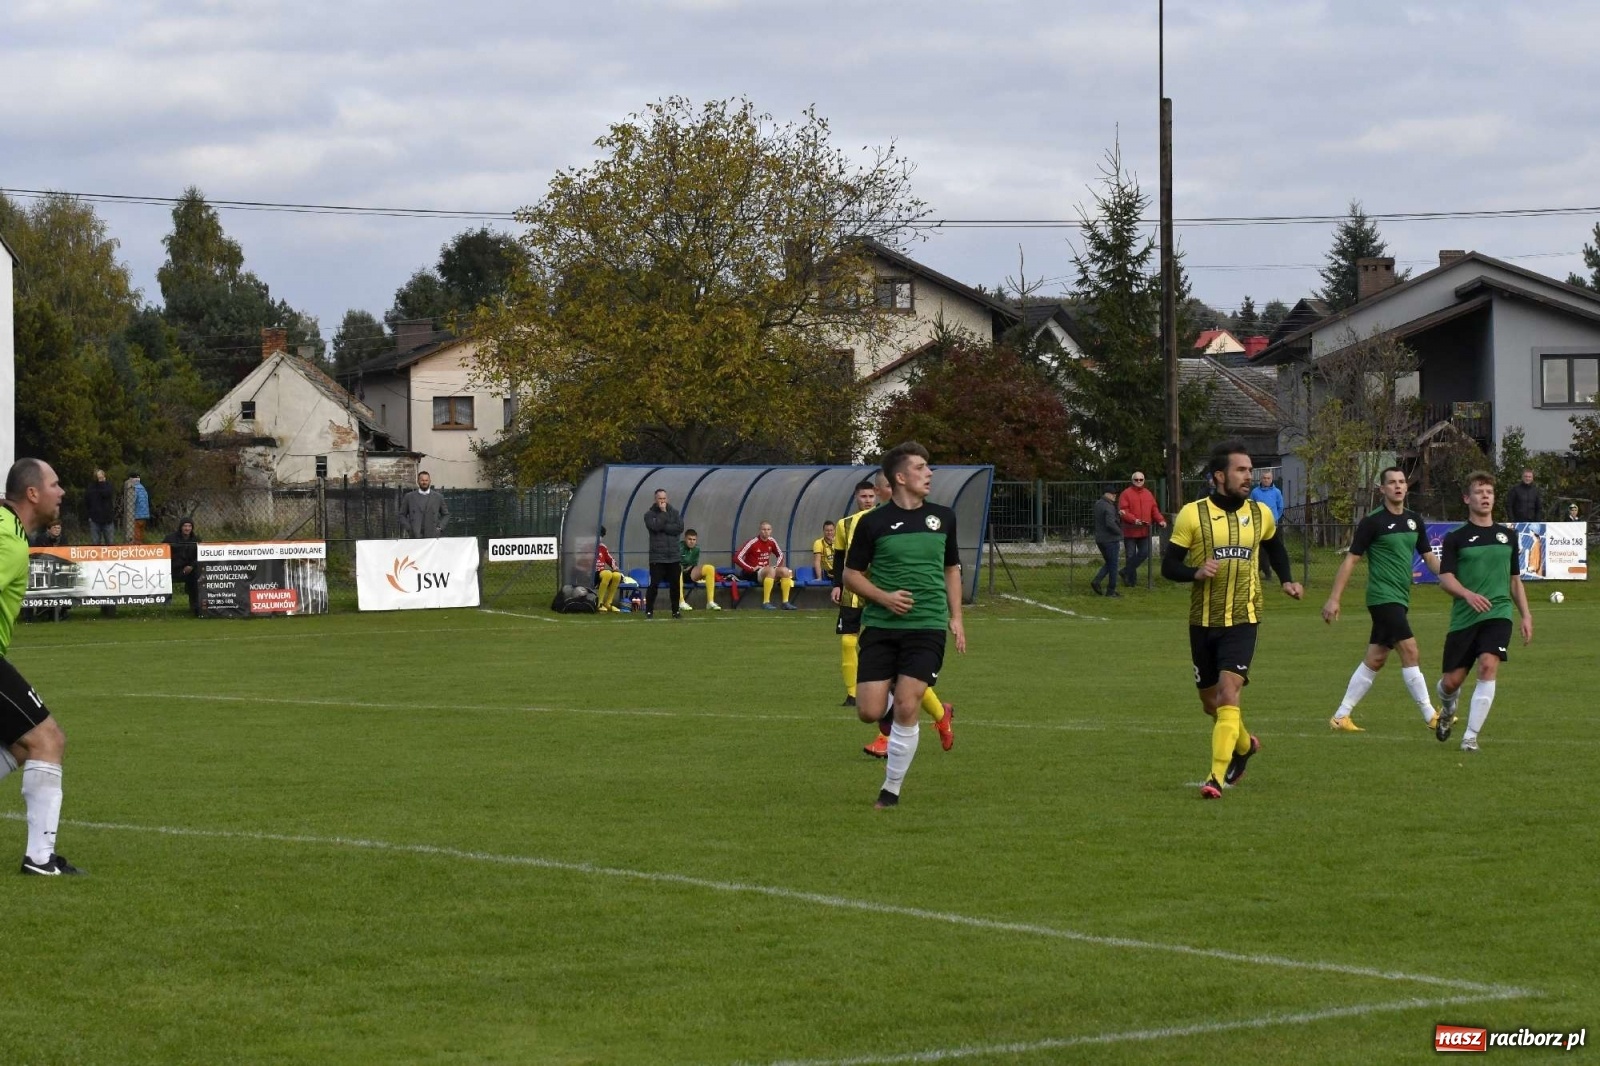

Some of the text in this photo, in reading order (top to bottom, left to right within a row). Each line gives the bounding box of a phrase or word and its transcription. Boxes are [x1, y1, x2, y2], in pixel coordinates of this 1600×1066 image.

[70, 547, 164, 560] Biuro Projektowe
[200, 549, 225, 557] USŁUGI
[228, 548, 274, 556] REMONTOWO
[280, 547, 322, 555] BUDOWLANE
[491, 543, 555, 556] GOSPODARZE
[1215, 547, 1251, 559] SEGET
[416, 572, 450, 593] JSW
[29, 599, 43, 607] 509
[59, 598, 73, 606] 946
[117, 597, 127, 605] ul.
[128, 597, 155, 606] Asnyka
[252, 601, 296, 609] SZALUNKÓW
